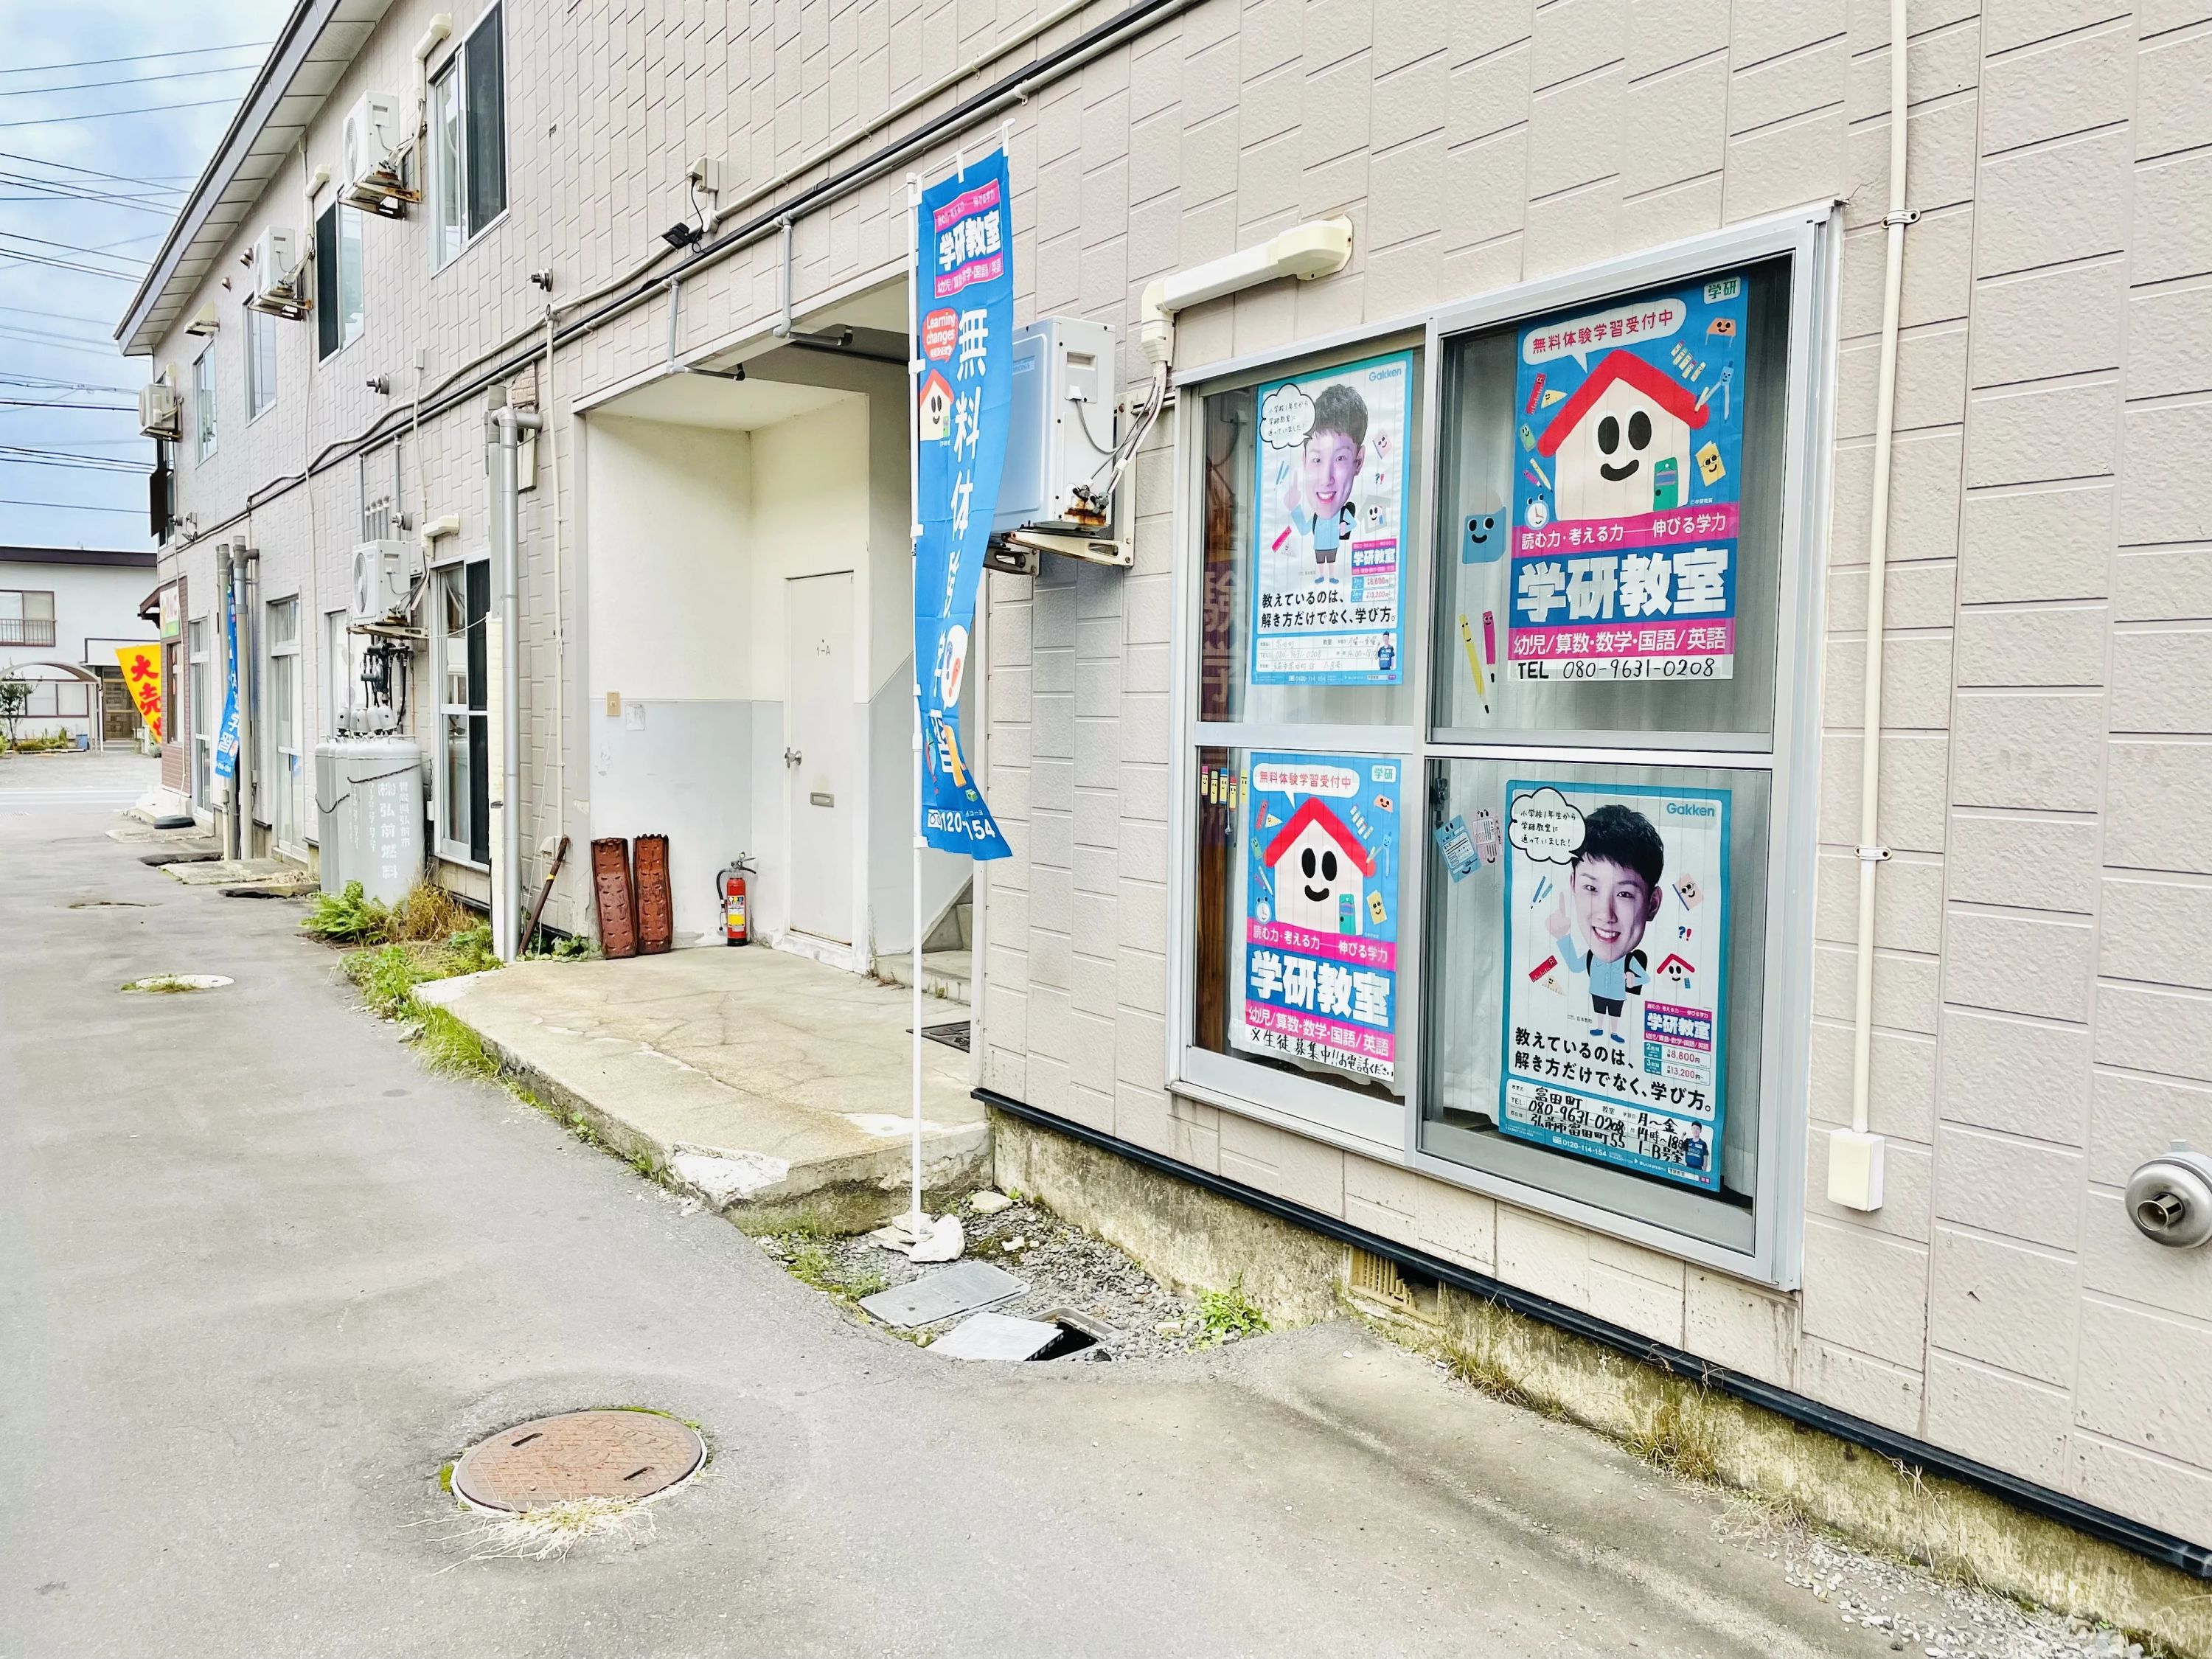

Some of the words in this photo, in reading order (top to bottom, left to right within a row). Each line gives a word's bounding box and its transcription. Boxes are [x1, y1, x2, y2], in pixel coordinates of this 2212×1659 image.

[939, 210, 1001, 271] 学研教室
[1708, 280, 1736, 299] 学研
[926, 313, 956, 330] Learning
[926, 328, 956, 345] changes
[1533, 309, 1673, 354] 無料体験学習受付中
[1369, 368, 1402, 382] Gakken
[1353, 548, 1396, 566] 学研教室
[1517, 547, 1729, 622] 学研教室
[1262, 590, 1344, 609] 教えているのは、
[1261, 606, 1395, 628] 解き方だけでなく、学び方。
[1518, 661, 1549, 679] TEL
[1563, 658, 1715, 679] 080-9631-0208
[1259, 771, 1352, 789] 無料体験学習受付中
[1374, 768, 1394, 779] 学研
[1520, 808, 1576, 821] 小学校1年生から
[1666, 802, 1716, 817] Gakken
[1521, 821, 1558, 832] 学研教室に
[1521, 832, 1571, 847] 通っていました!
[1251, 950, 1390, 1027] 学研教室
[1646, 1012, 1711, 1040] 学研教室
[1515, 1026, 1634, 1069] 教えているのは、
[1514, 1050, 1712, 1113] 解き方だけでなく、学び方。
[1535, 1086, 1583, 1110] 富田町
[1528, 1100, 1624, 1135] 080-9631-0208
[1562, 1139, 1607, 1157] 0120-114-154
